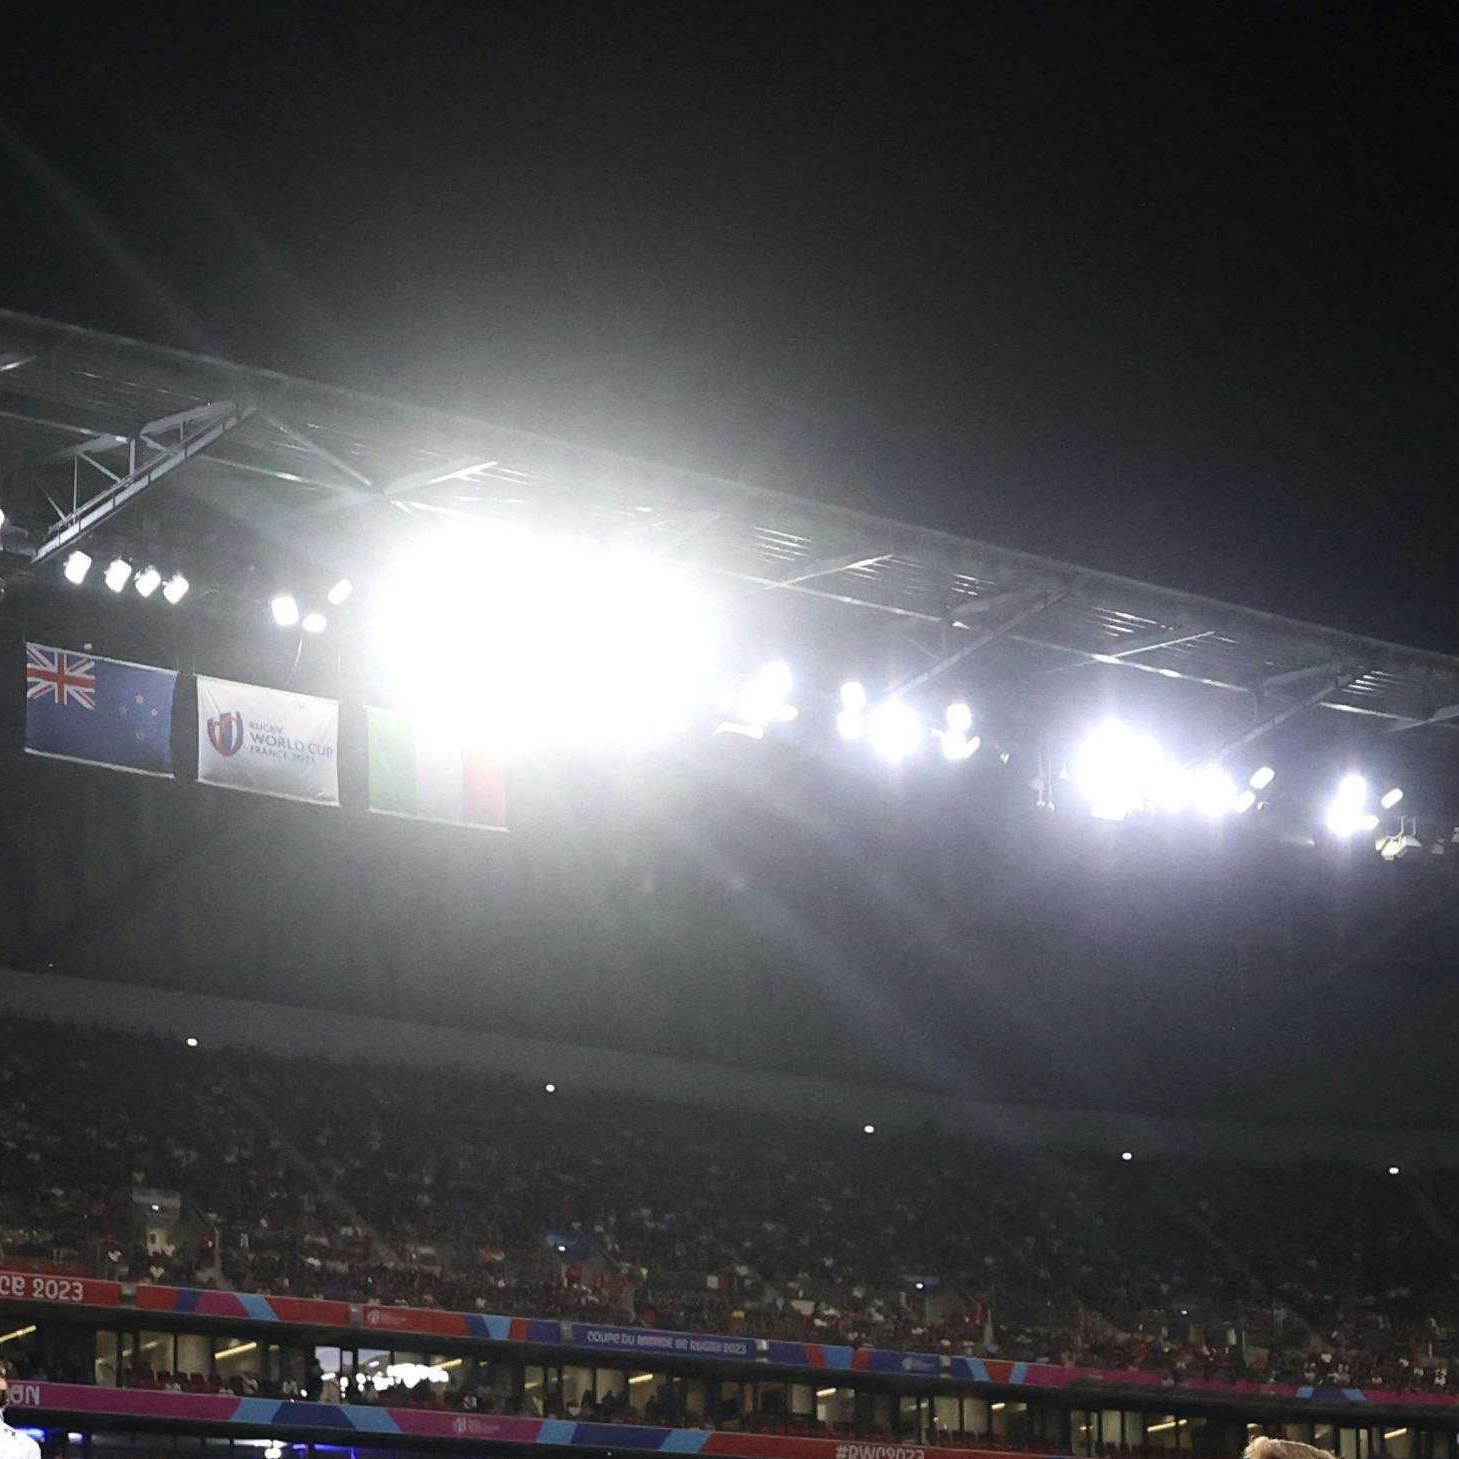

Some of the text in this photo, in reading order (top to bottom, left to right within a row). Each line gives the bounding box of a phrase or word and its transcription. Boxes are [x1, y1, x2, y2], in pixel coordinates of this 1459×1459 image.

[250, 732, 334, 757] WORLD CUP
[250, 744, 289, 761] FRANCE
[32, 1278, 84, 1302] 2023
